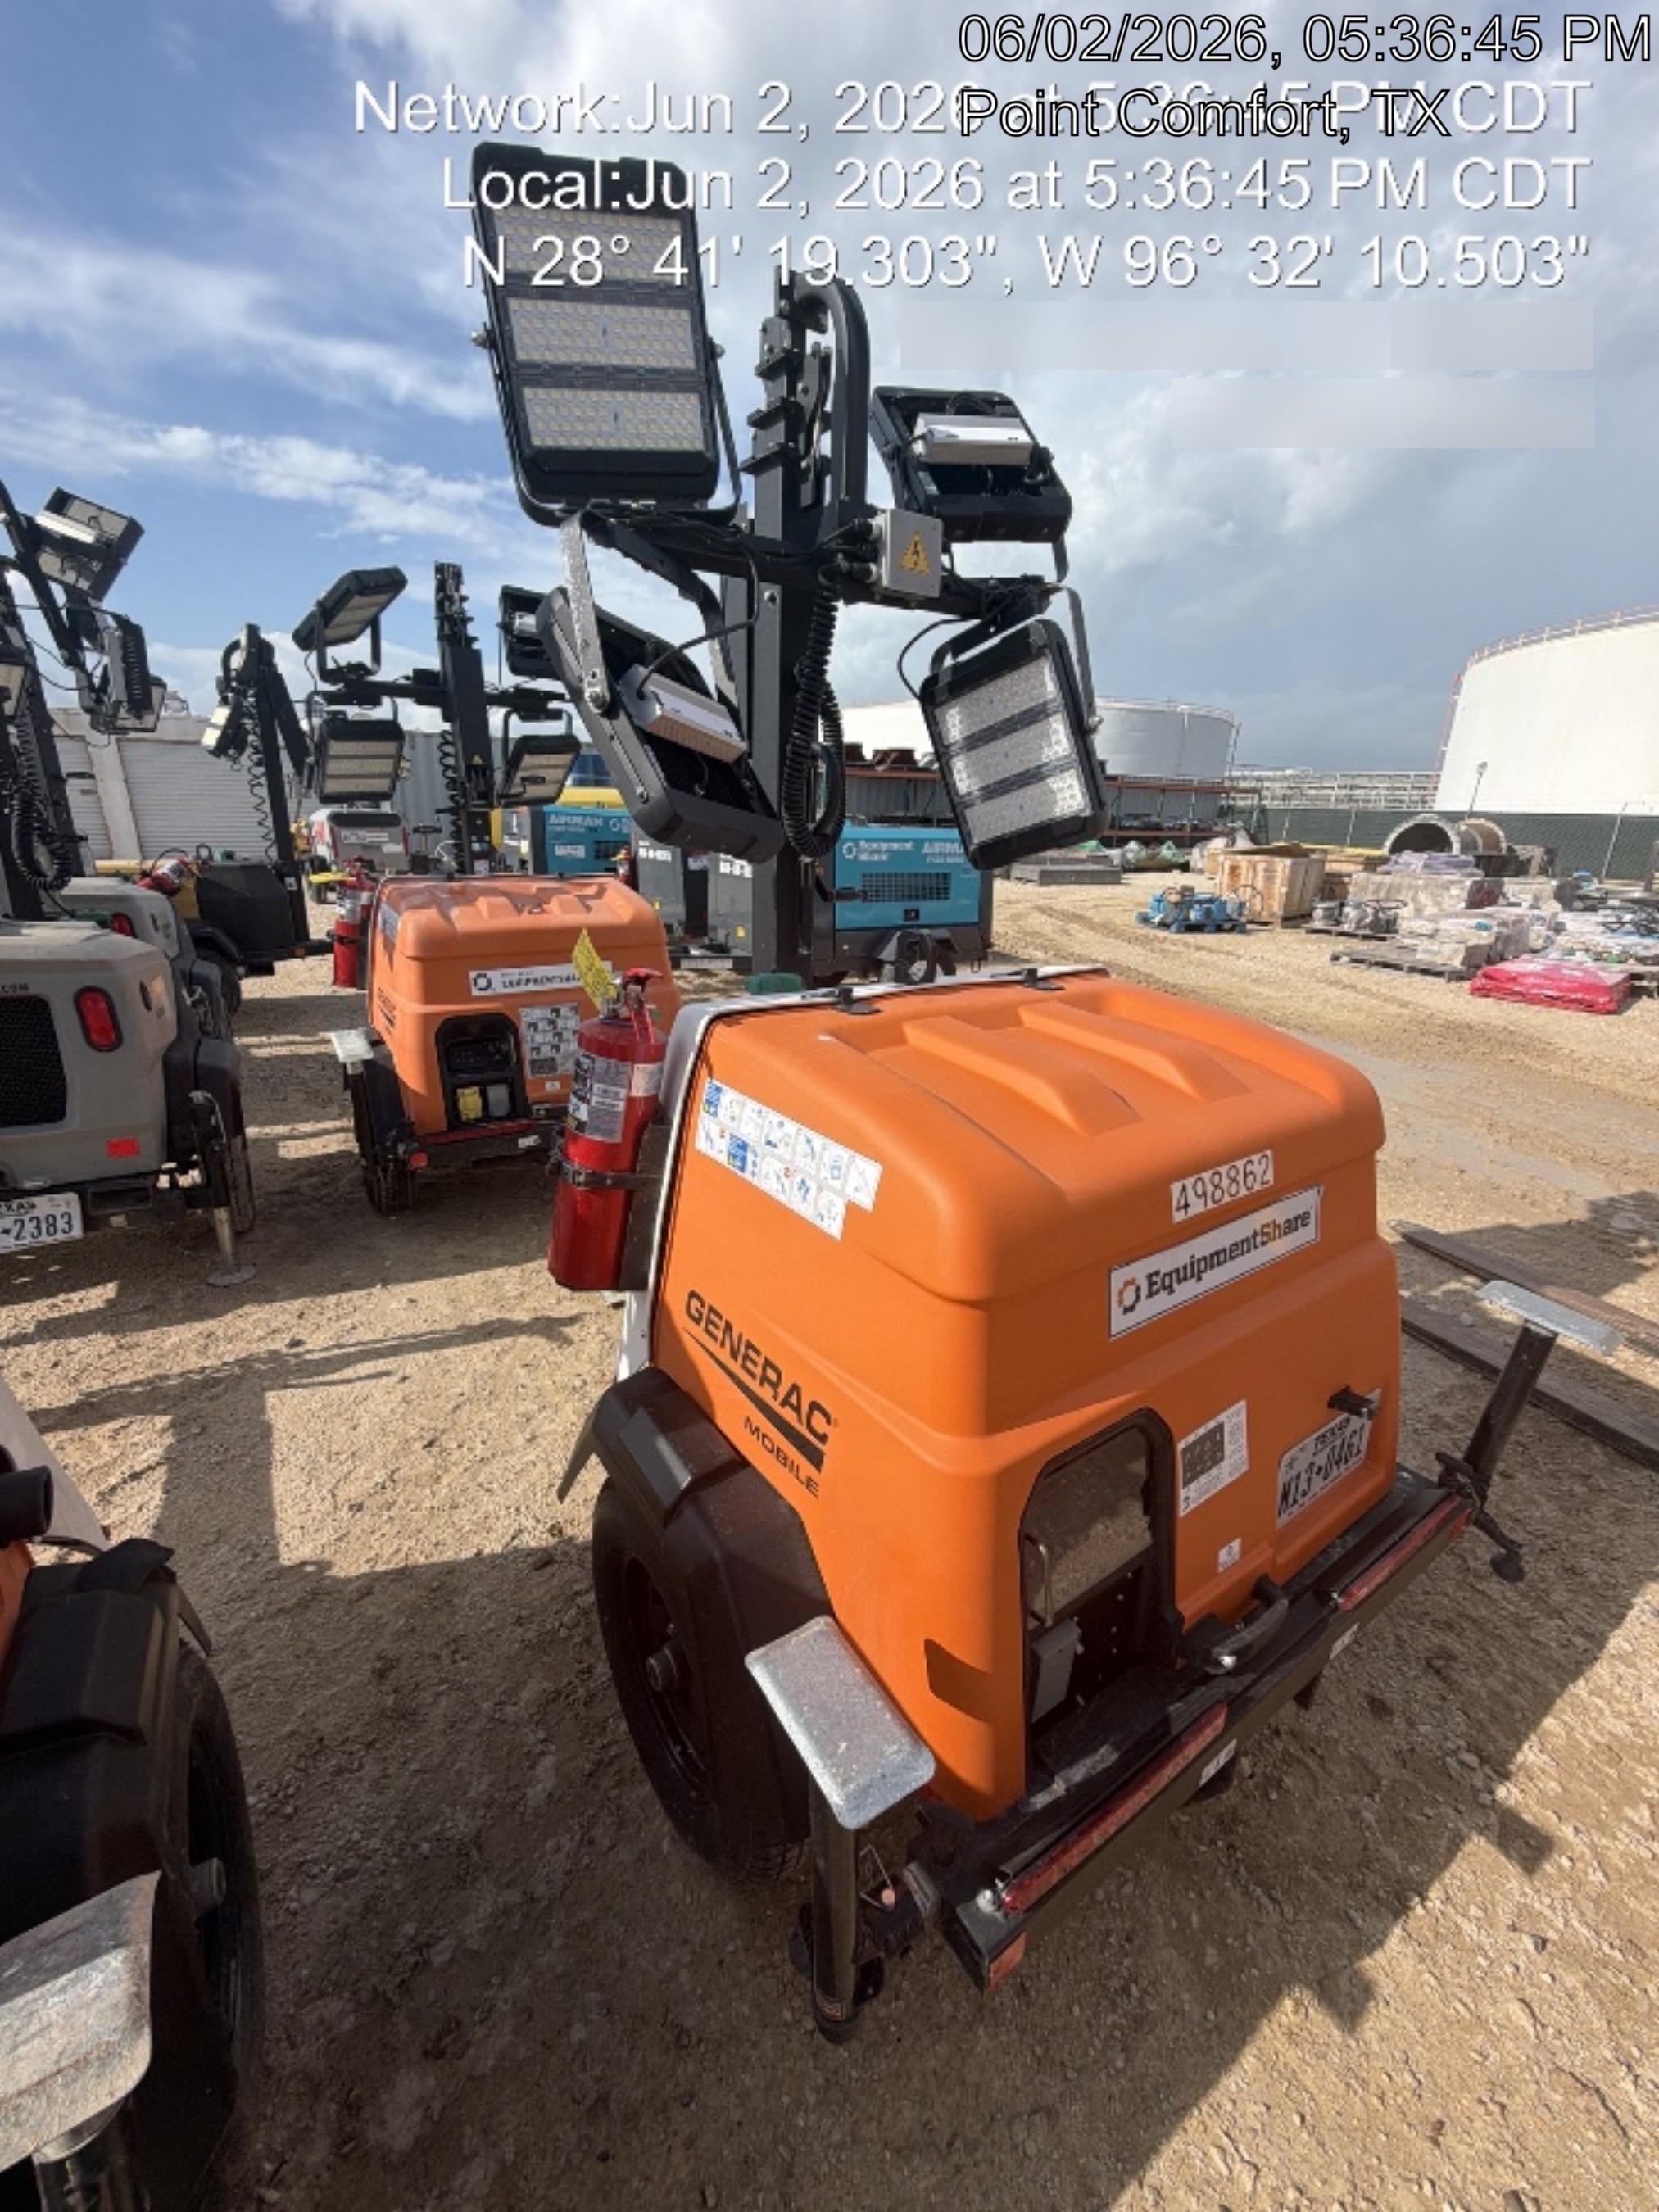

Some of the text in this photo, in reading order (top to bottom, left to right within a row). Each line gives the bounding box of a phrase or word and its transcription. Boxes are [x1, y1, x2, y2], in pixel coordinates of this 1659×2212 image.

[1175, 1153, 1272, 1217] 498862
[1145, 1209, 1312, 1300] EquipmentShare
[684, 1289, 833, 1447] GENERAC
[743, 1415, 821, 1501] MOBILE
